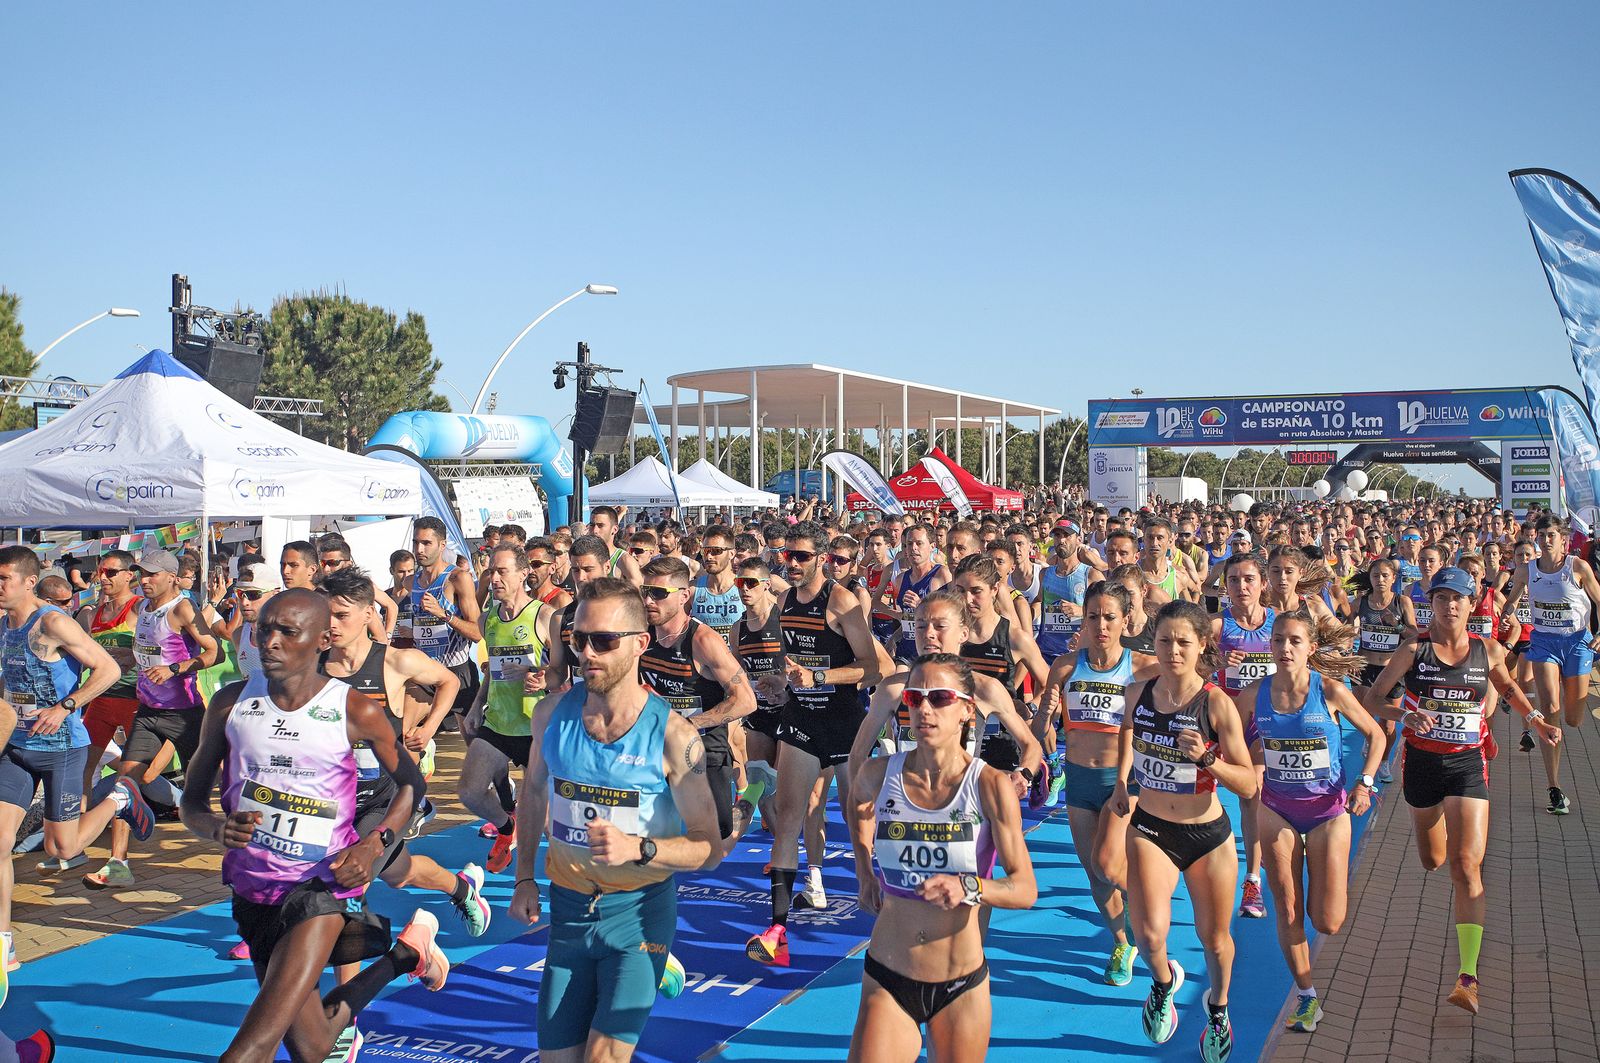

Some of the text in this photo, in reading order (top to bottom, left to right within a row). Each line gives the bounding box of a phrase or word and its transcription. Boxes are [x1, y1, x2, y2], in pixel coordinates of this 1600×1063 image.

[1242, 400, 1345, 413] CAMPEONATO
[1508, 406, 1549, 419] WiHu
[1242, 412, 1383, 428] de ESPAÑA 10 km
[1425, 407, 1469, 420] HUELVA
[486, 423, 519, 440] HUELVA
[1202, 427, 1223, 435] WiHu
[1310, 429, 1345, 437] Absoluto
[1355, 428, 1383, 436] Master
[95, 478, 174, 502] Cepaim
[853, 499, 938, 509] SPOANIACS
[697, 601, 738, 617] nerja
[1416, 609, 1433, 618] 412
[1541, 611, 1562, 620] 404
[421, 628, 433, 637] 29
[796, 634, 816, 643] VICKY
[1369, 634, 1390, 643] 407
[1239, 665, 1268, 677] 403
[1447, 690, 1471, 700] BM
[1080, 694, 1112, 710] 408
[1435, 714, 1466, 730] 432
[1154, 734, 1174, 746] BM
[1158, 753, 1181, 763] LOOP
[1278, 753, 1312, 769] 426
[1142, 758, 1176, 780] 402
[580, 786, 629, 799] RUNNING
[279, 792, 330, 808] RUNNING
[592, 796, 619, 806] LOOP
[289, 805, 320, 815] LOOP
[271, 812, 300, 838] 11
[912, 823, 962, 833] RUNNING
[899, 845, 949, 869] 409
[677, 885, 772, 900] UELVA
[363, 1030, 515, 1060] HUELVA
